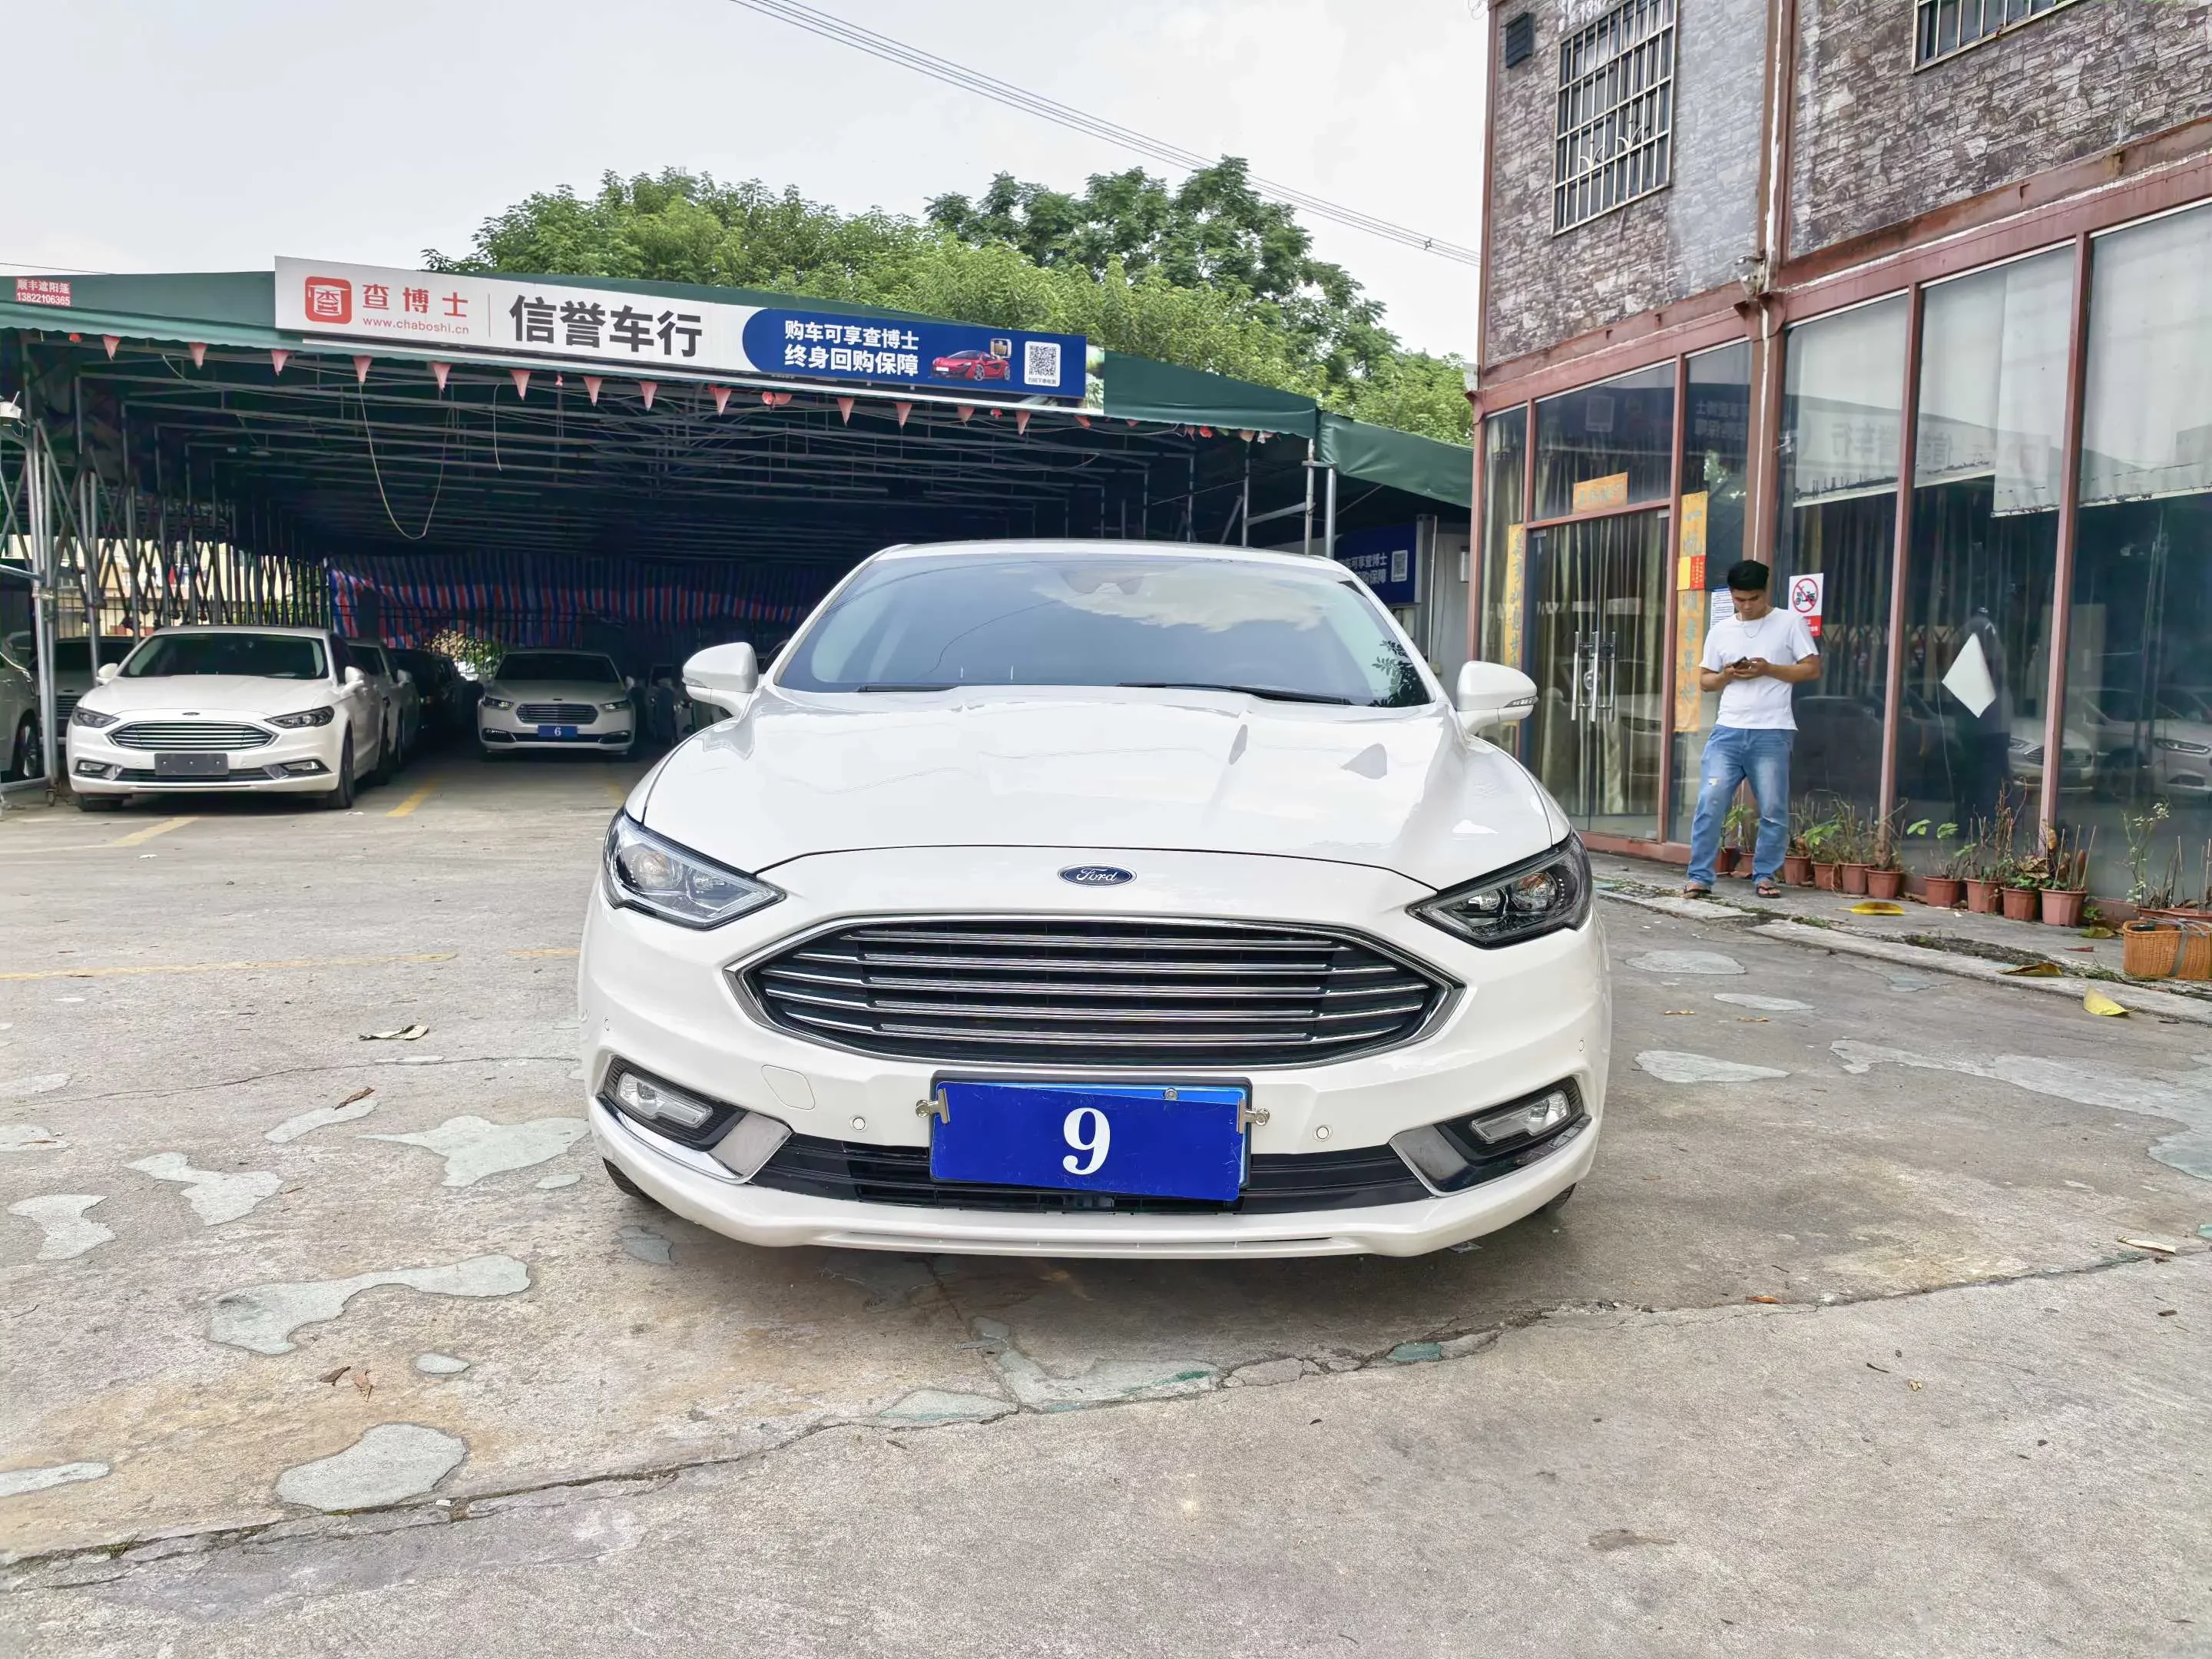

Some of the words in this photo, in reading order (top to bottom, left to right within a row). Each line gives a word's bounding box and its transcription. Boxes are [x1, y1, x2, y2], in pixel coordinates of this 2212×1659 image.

[17, 293, 70, 306] 13822106365
[363, 283, 469, 317] 查博士
[363, 317, 469, 335] www.chaboshi.cn
[509, 294, 702, 357] 信誉车行
[784, 320, 919, 350] 购车可享查博士
[784, 343, 919, 376] 终身回购保障
[555, 727, 561, 737] 6
[1076, 868, 1118, 881] Ford
[1062, 1107, 1111, 1175] 9
